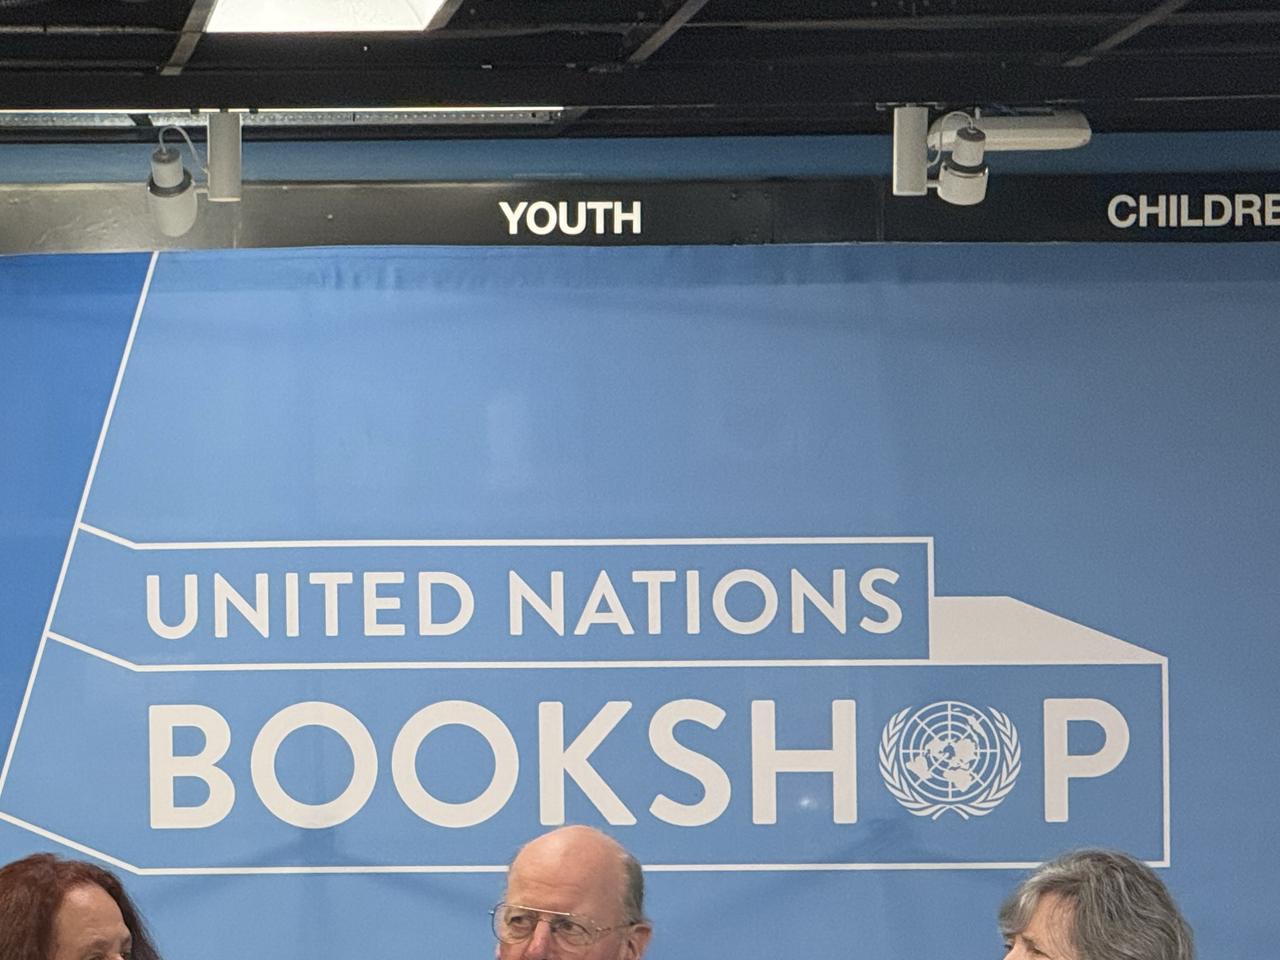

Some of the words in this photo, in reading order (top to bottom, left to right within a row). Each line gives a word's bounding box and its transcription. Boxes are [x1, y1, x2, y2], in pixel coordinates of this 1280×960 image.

[499, 201, 642, 235] YOUTH
[1107, 193, 1280, 228] CHILDRE
[146, 571, 475, 639] UNITED
[509, 568, 903, 637] NATIONS
